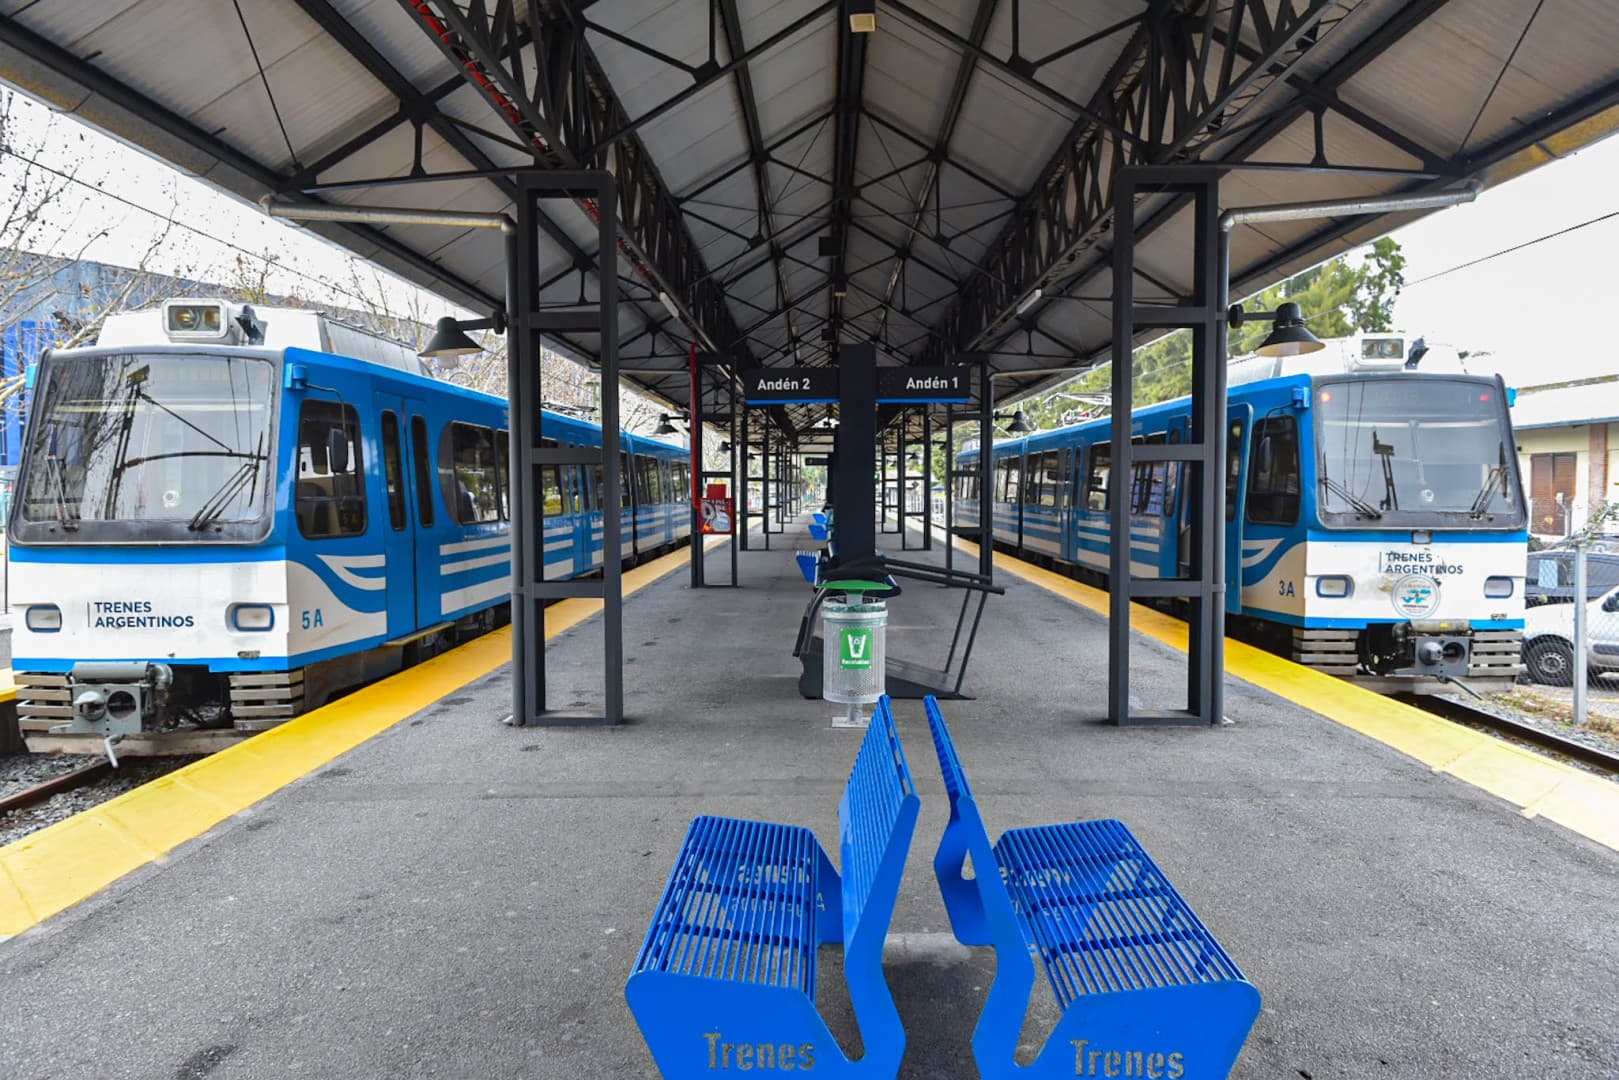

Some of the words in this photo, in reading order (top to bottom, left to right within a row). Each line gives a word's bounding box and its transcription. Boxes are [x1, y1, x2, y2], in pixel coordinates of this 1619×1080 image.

[757, 377, 799, 391] Andén
[802, 378, 811, 391] 2
[906, 376, 948, 390] Andén
[951, 377, 959, 389] 1
[1386, 552, 1433, 563] TRENES
[1385, 564, 1464, 575] ARGENTINOS
[1279, 580, 1296, 597] 3A
[94, 601, 152, 613] TRENES
[95, 616, 194, 628] ARGENTINOS
[703, 1032, 816, 1071] Trenes
[1070, 1039, 1185, 1079] Trenes
